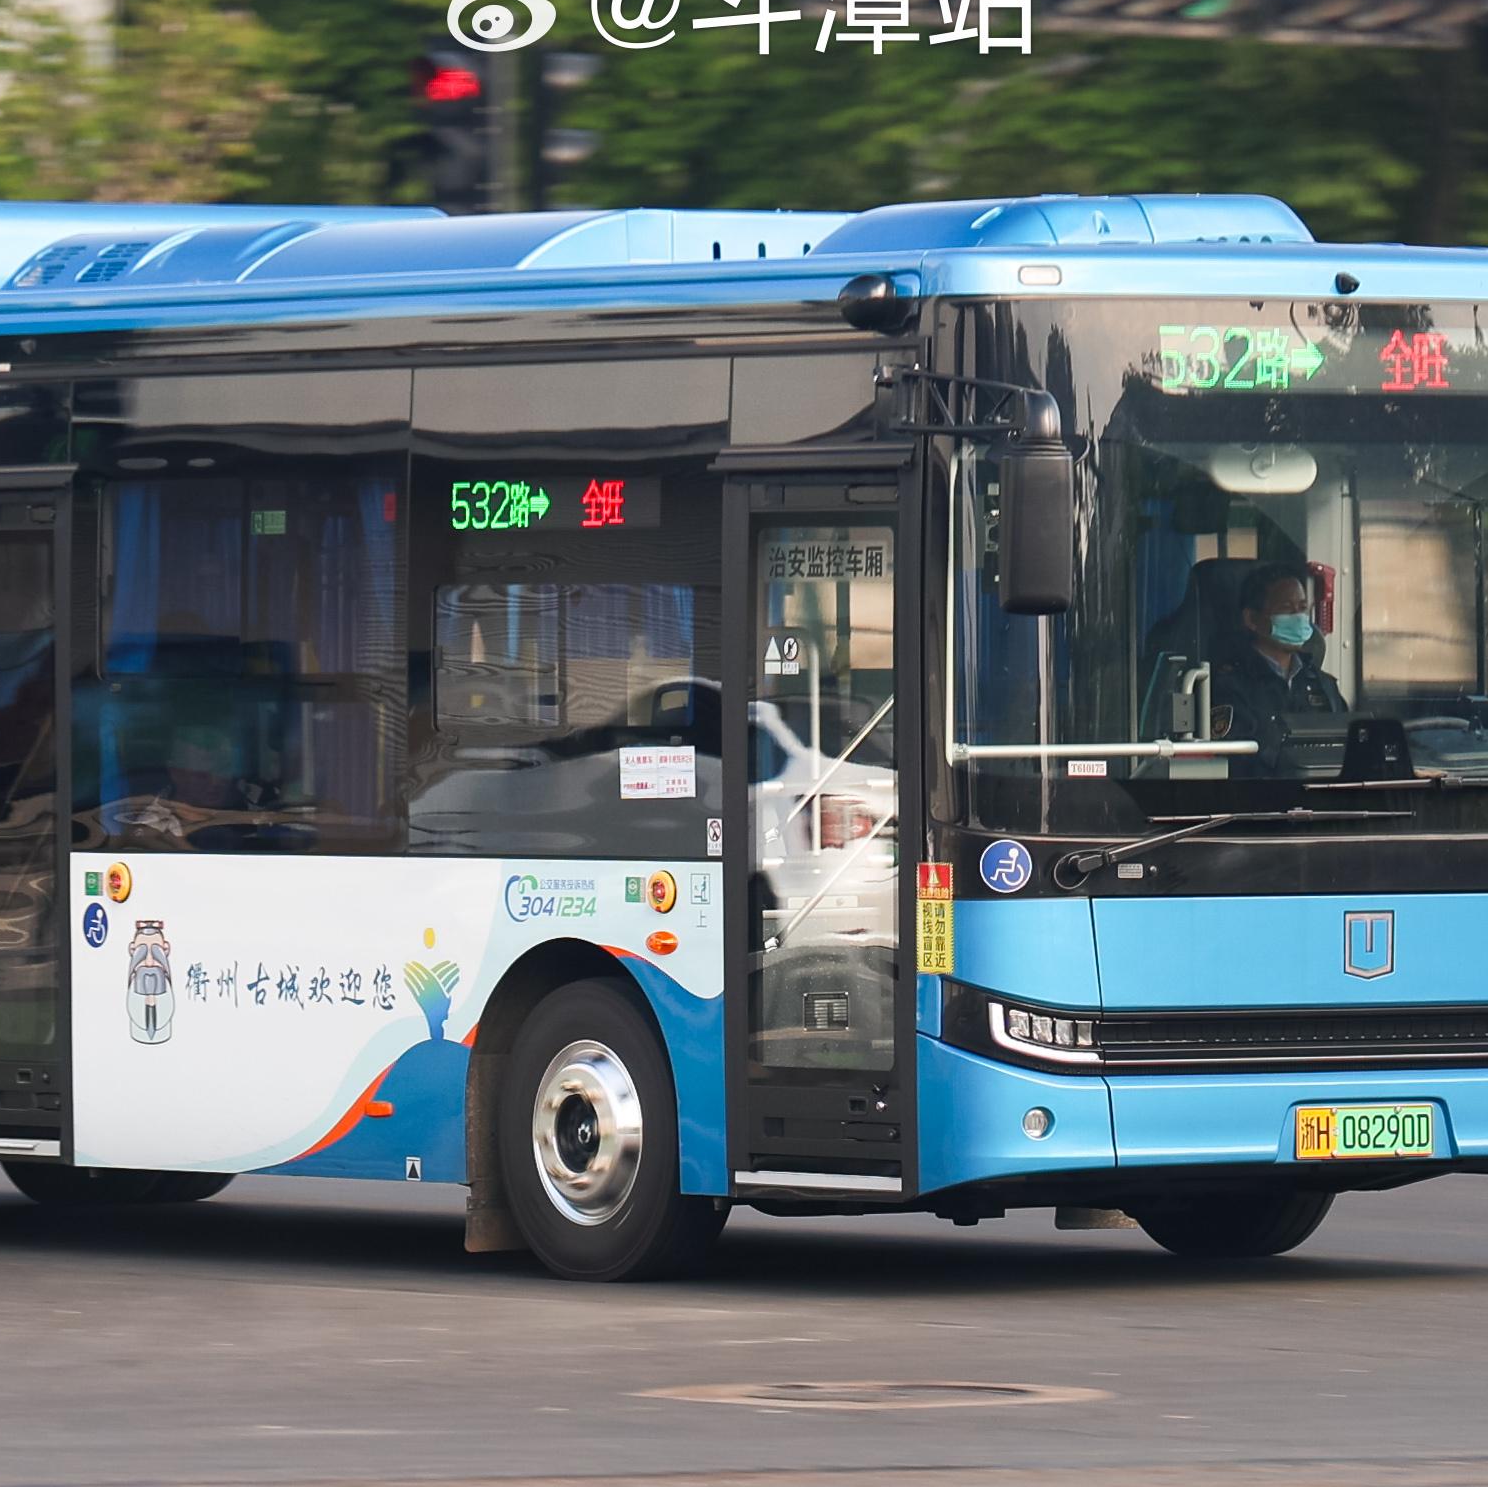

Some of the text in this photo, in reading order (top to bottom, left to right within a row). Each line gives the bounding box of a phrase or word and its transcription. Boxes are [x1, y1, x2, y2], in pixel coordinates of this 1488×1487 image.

[1159, 325, 1451, 392] 532路 全旺
[452, 478, 625, 530] 532路 全旺
[769, 546, 884, 578] 治安监控车厢
[923, 902, 933, 968] 视线盲区
[934, 902, 947, 968] 请勿靠近
[185, 961, 396, 1011] 衢州古城欢迎您
